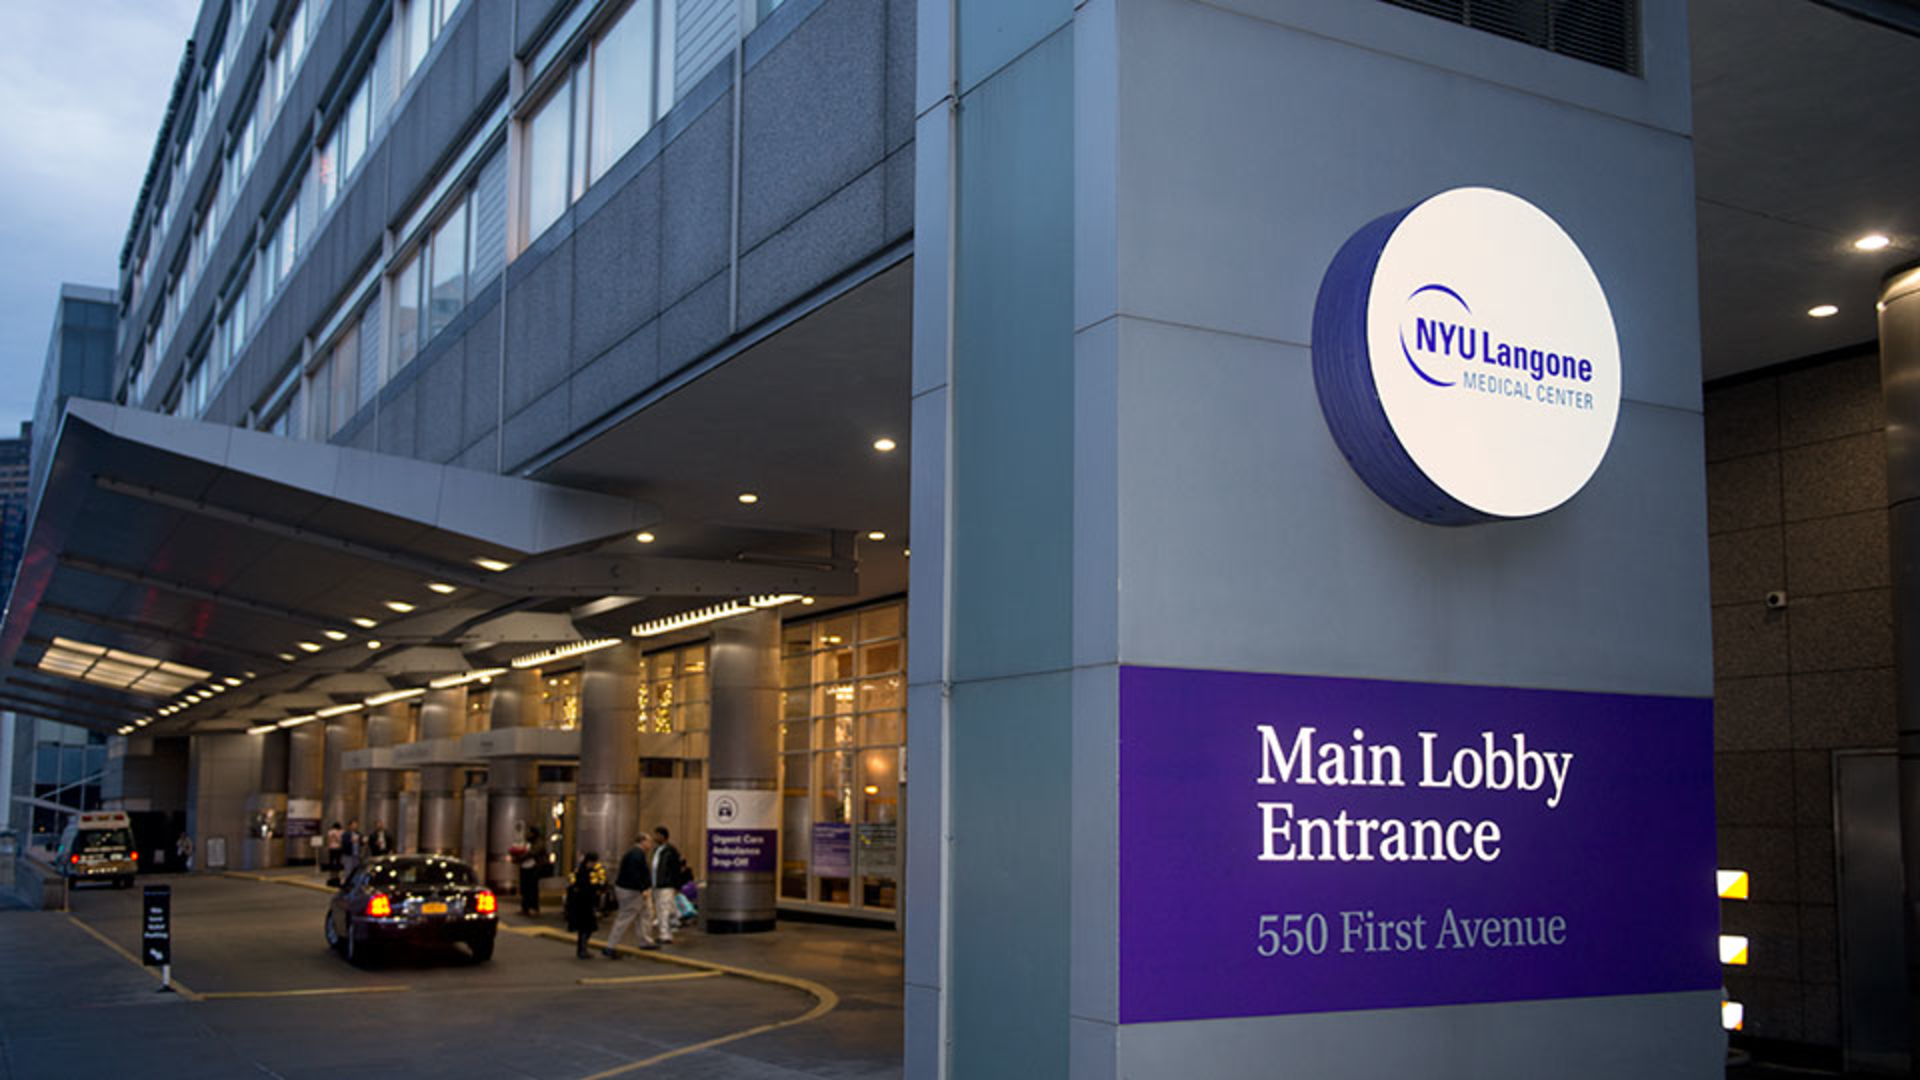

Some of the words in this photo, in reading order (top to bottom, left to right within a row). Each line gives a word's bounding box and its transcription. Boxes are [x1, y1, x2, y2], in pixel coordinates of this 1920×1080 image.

[1416, 317, 1476, 360] NYU
[1482, 330, 1593, 383] Langone
[1463, 371, 1532, 401] MEDICAL
[1536, 384, 1594, 411] CENTER
[1257, 724, 1404, 787] Main
[1417, 731, 1574, 808] Lobby
[1257, 802, 1501, 863] Entrance
[1257, 912, 1328, 957] 550
[1339, 910, 1427, 953] First
[1435, 907, 1566, 949] Avenue
